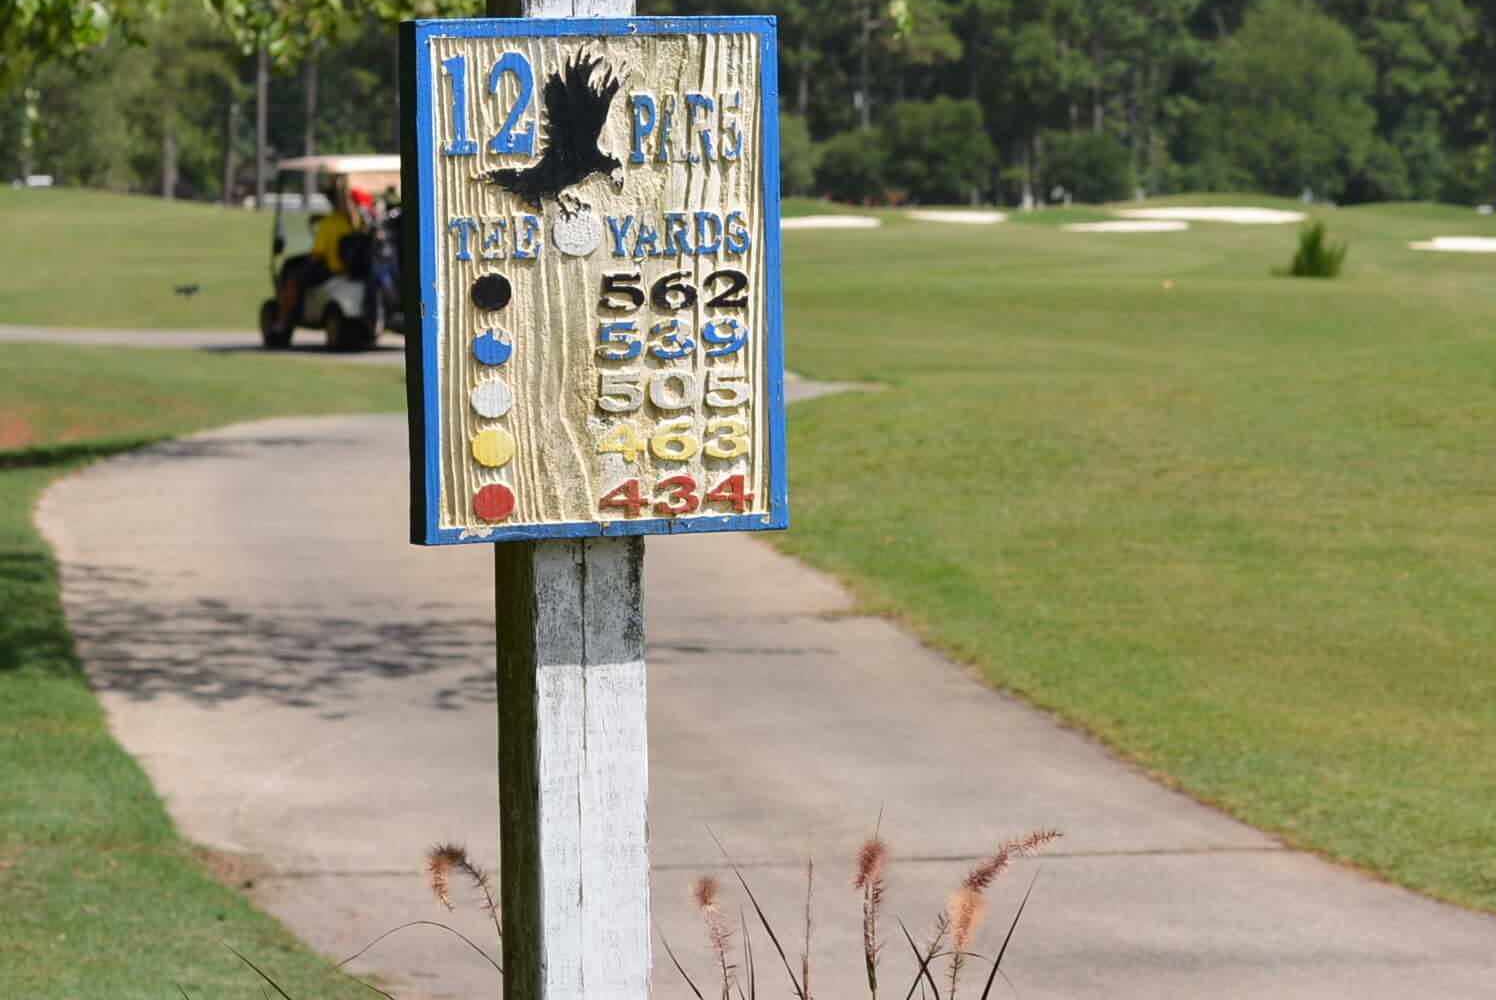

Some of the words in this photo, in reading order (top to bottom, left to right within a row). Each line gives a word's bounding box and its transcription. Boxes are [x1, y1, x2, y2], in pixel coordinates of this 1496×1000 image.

[440, 51, 536, 156] 12
[449, 214, 541, 261] TEE
[606, 210, 750, 257] YARDS
[600, 269, 748, 310] 562
[597, 317, 748, 361] 539
[598, 367, 750, 412] 505
[597, 418, 749, 462] 463
[600, 474, 754, 517] 434
